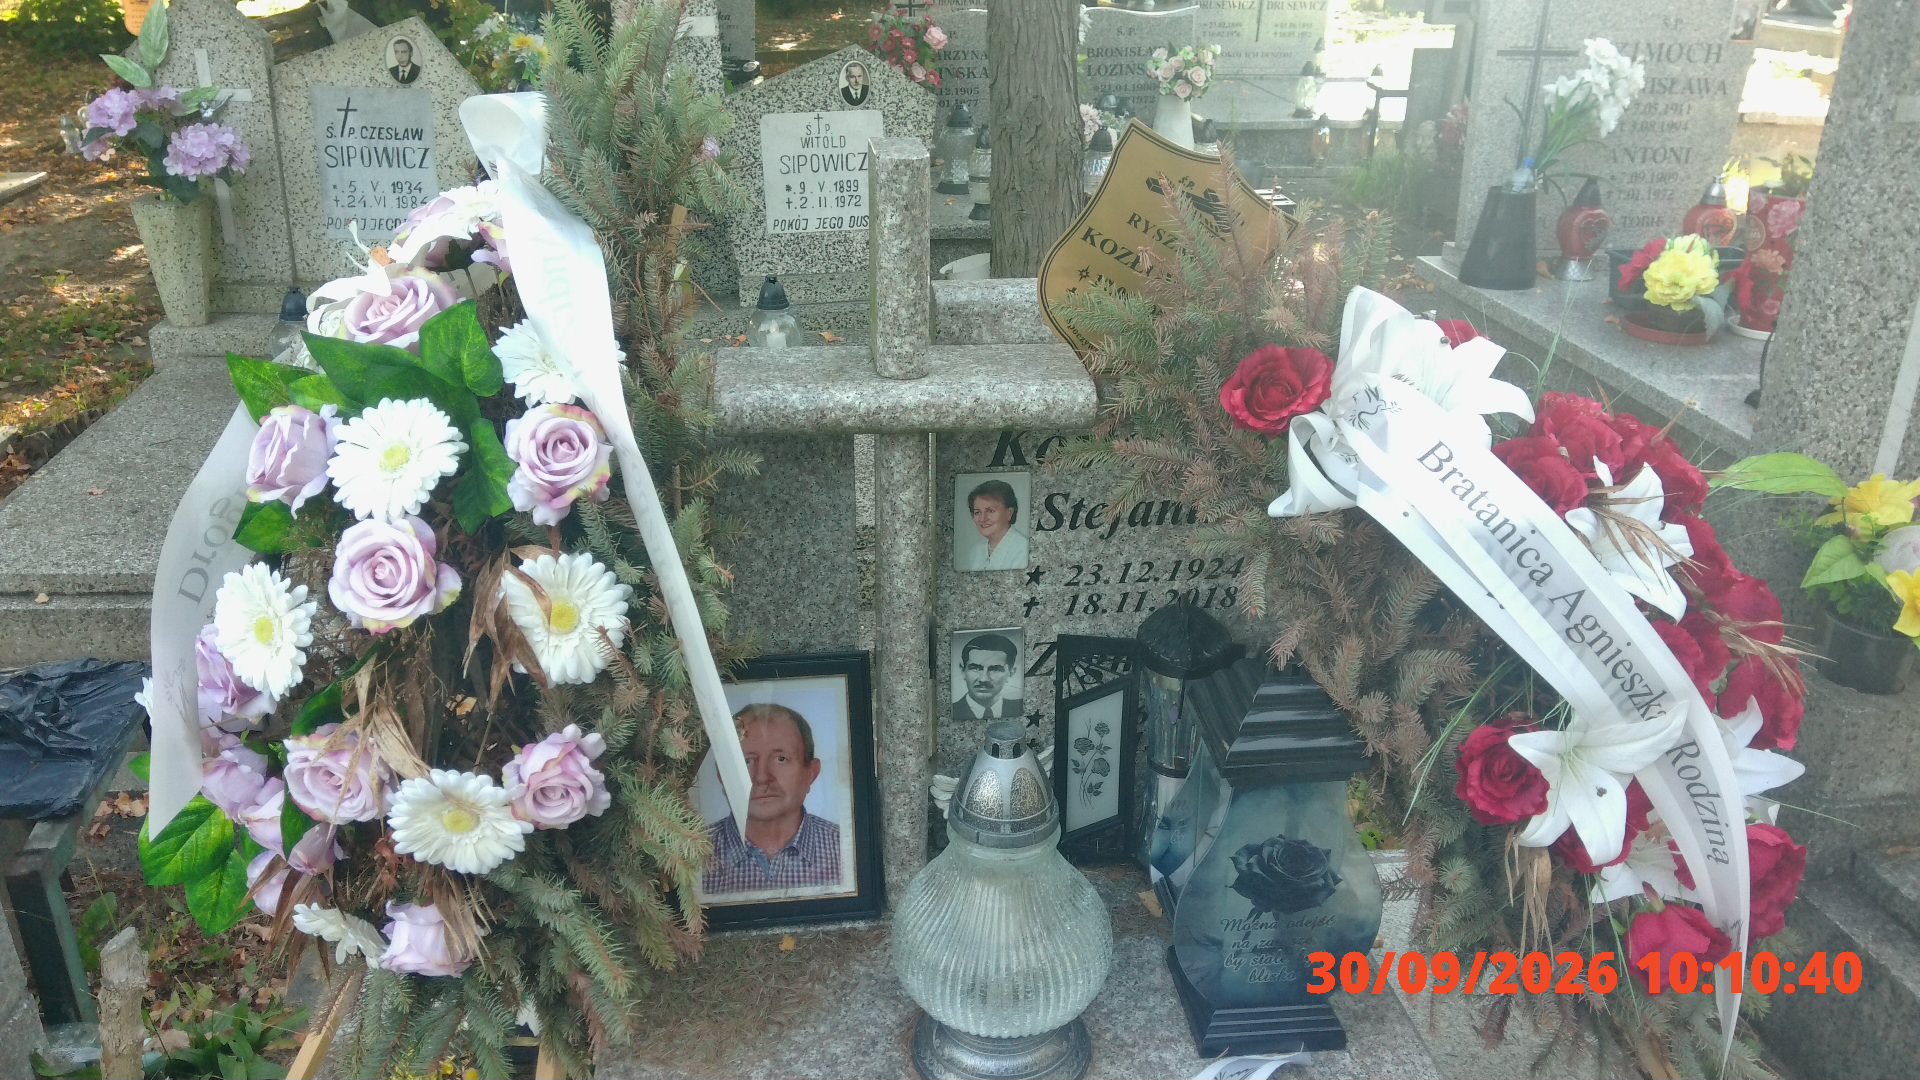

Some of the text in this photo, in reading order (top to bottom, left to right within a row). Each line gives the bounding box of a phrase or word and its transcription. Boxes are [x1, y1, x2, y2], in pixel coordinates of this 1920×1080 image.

[360, 126, 425, 141] CZESŁAW
[800, 135, 847, 149] WITOLD
[323, 144, 431, 170] SIPOWICZ
[779, 152, 868, 175] SIPOWICZ
[772, 215, 809, 232] POKÓJ
[815, 217, 844, 230] JEGO
[1064, 556, 1245, 587] 23.12.1924
[1415, 440, 1555, 588] Bratanica
[1665, 738, 1730, 865] Rodziną
